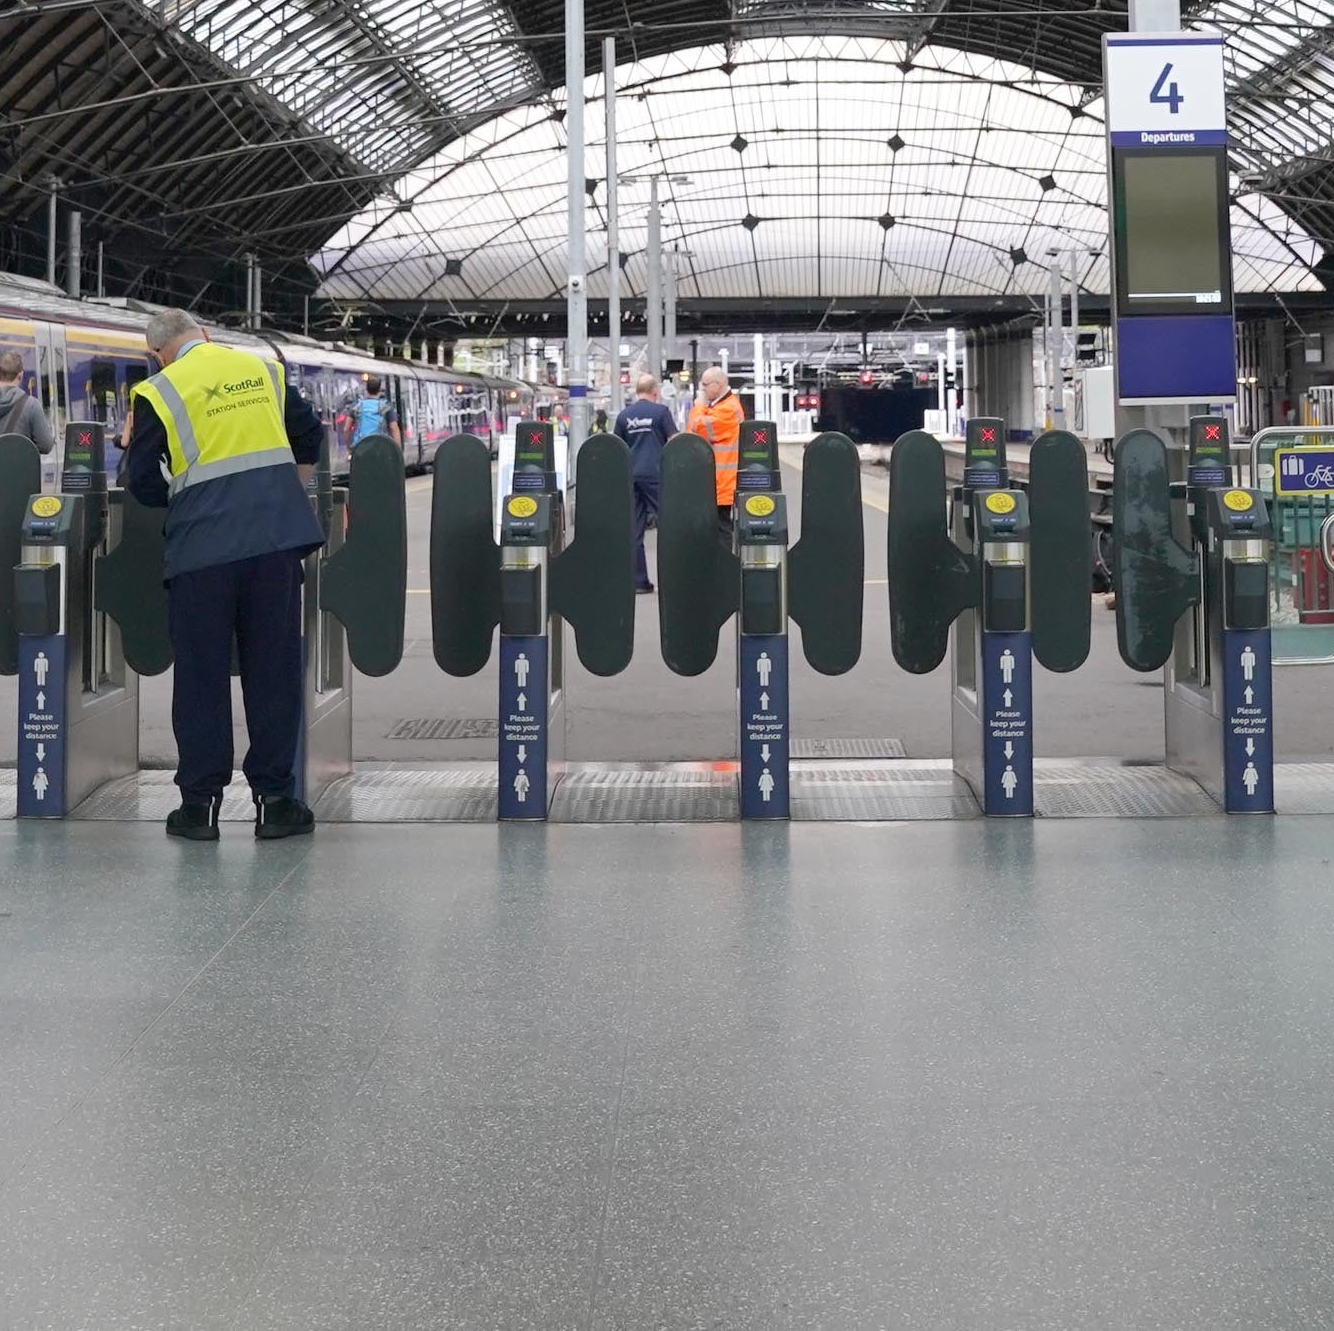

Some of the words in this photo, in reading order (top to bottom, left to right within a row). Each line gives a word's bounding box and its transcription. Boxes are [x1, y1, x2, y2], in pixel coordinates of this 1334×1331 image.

[1148, 63, 1185, 114] 4
[1140, 131, 1196, 144] Departures
[223, 377, 265, 394] ScotRail
[206, 403, 237, 418] STATION
[237, 396, 270, 408] SERVICES
[29, 713, 54, 721] Please
[23, 723, 41, 731] keep
[42, 723, 59, 732] your
[25, 732, 57, 740] distance
